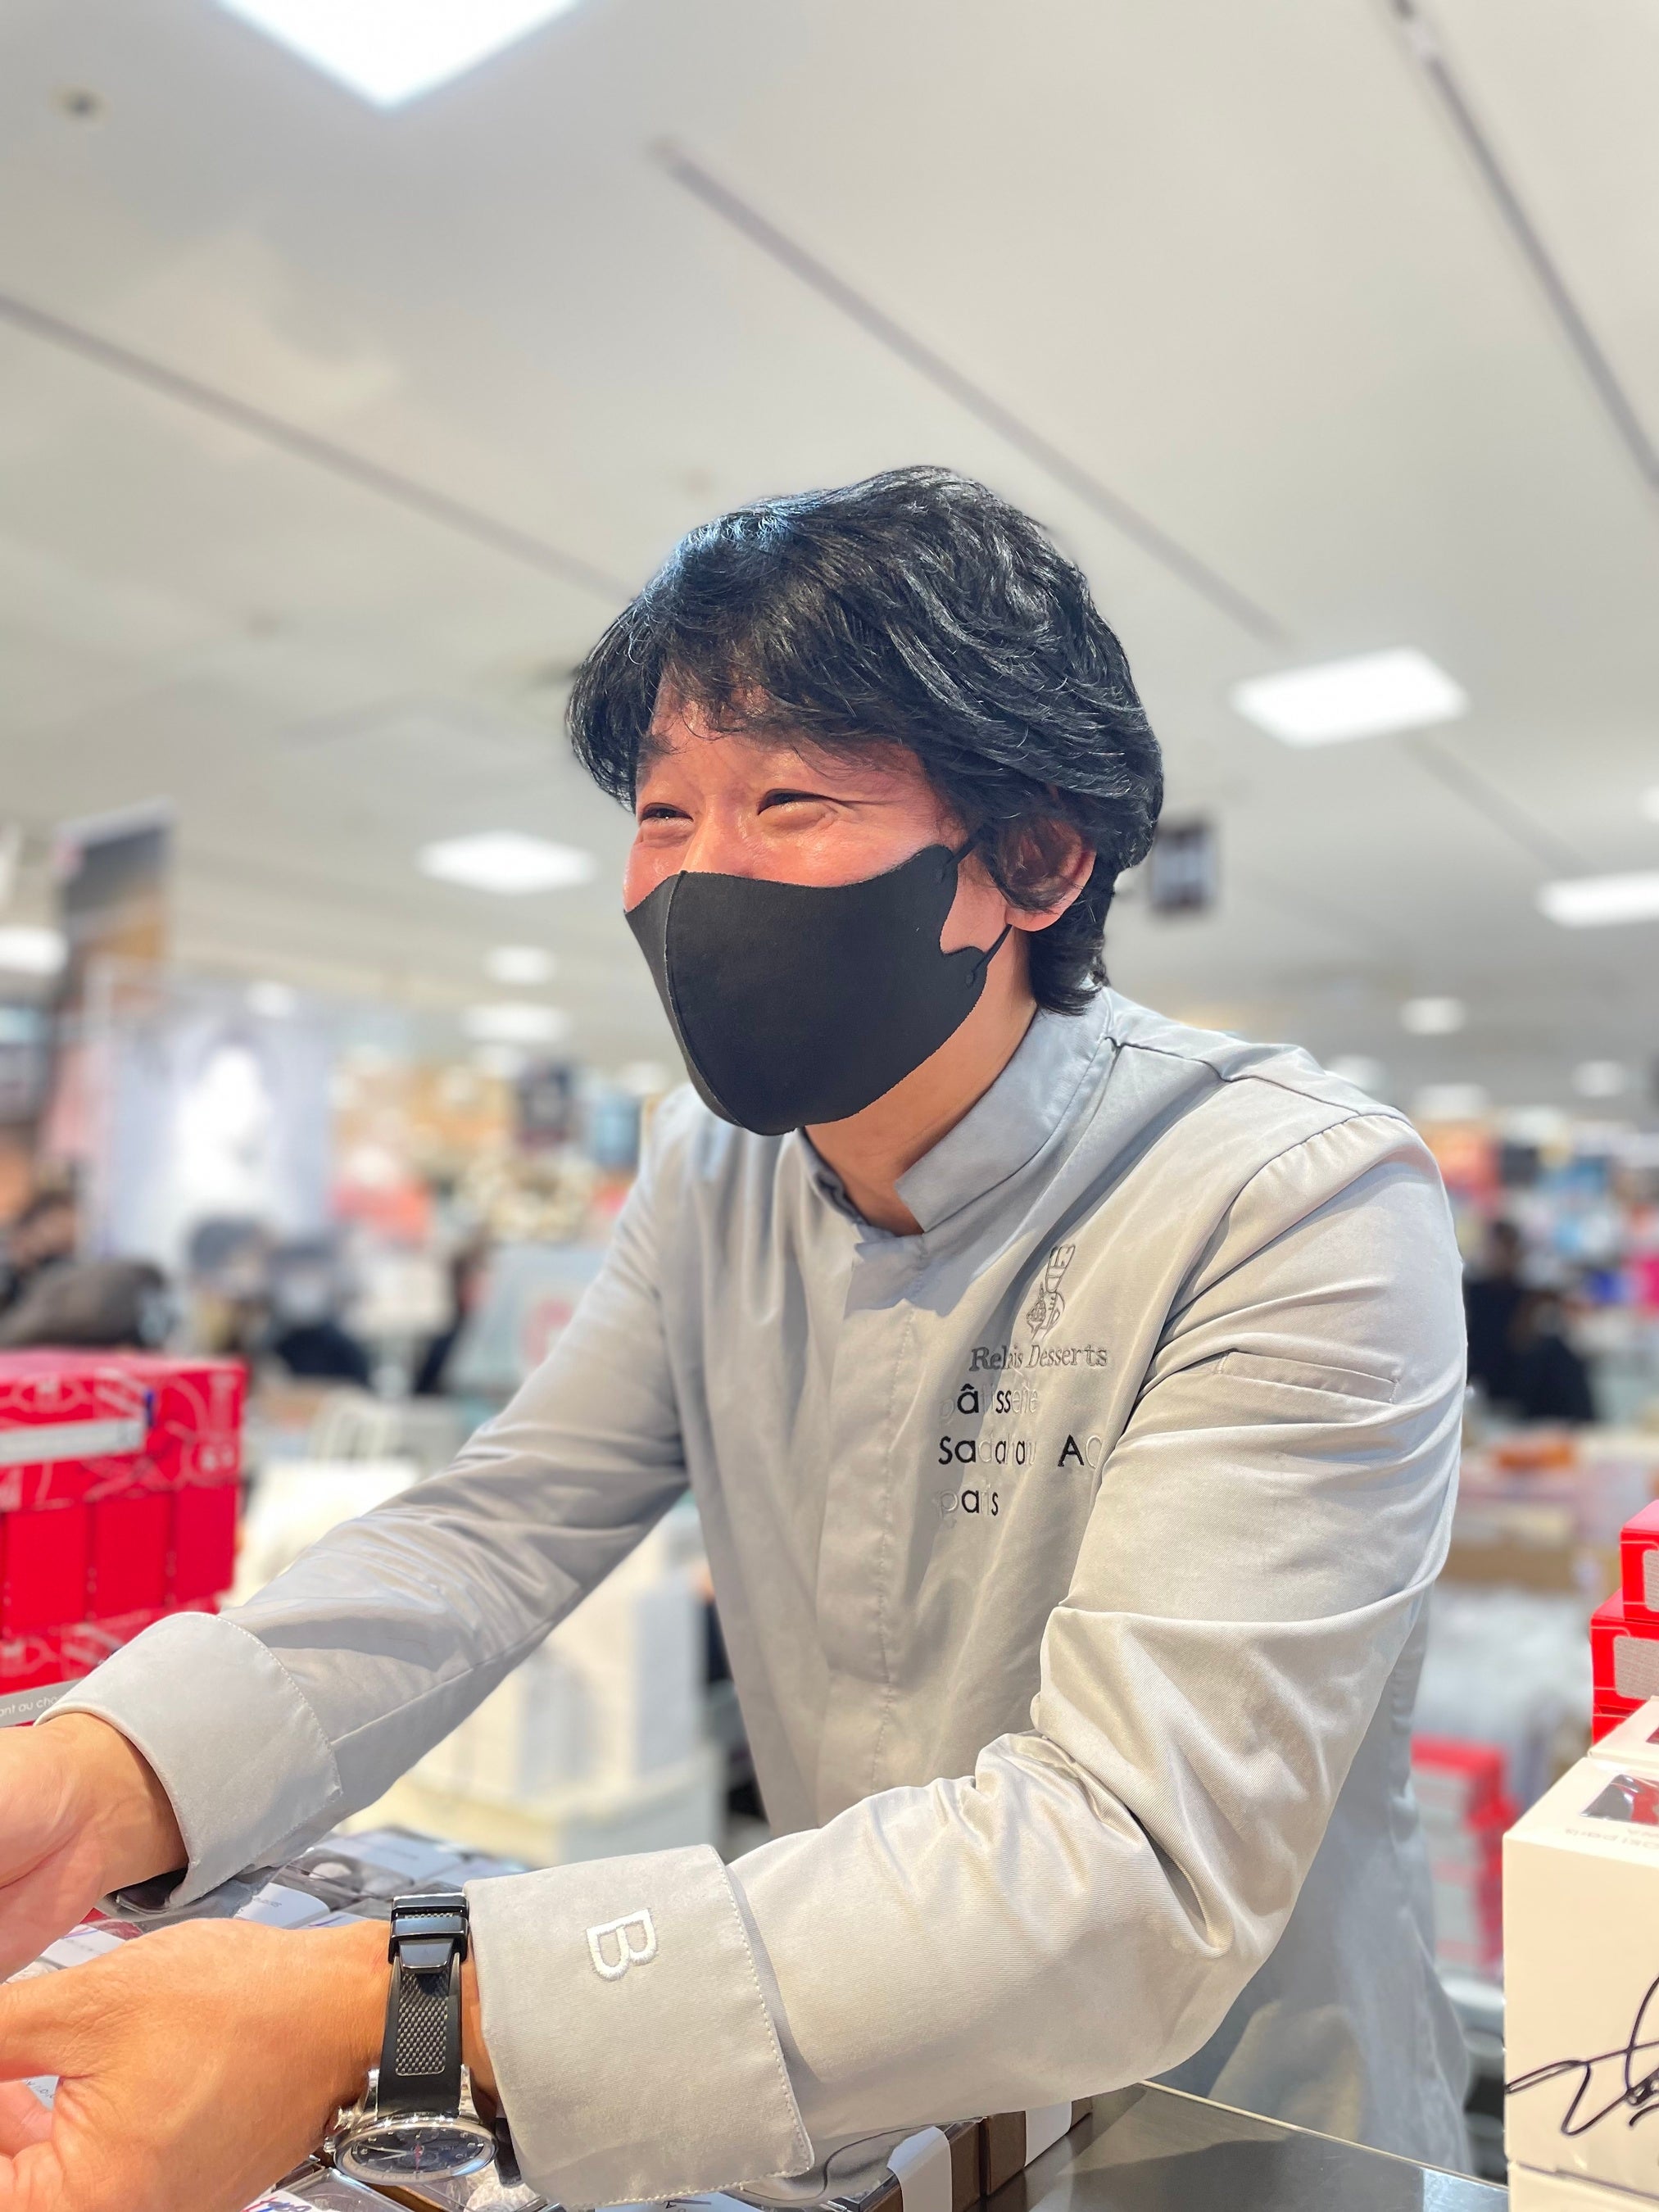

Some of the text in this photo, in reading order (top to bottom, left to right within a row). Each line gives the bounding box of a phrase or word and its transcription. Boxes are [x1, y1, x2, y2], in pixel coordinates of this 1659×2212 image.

[968, 1344, 1108, 1371] Relais Desserts
[36, 1696, 59, 1709] cho
[586, 1909, 657, 1982] B
